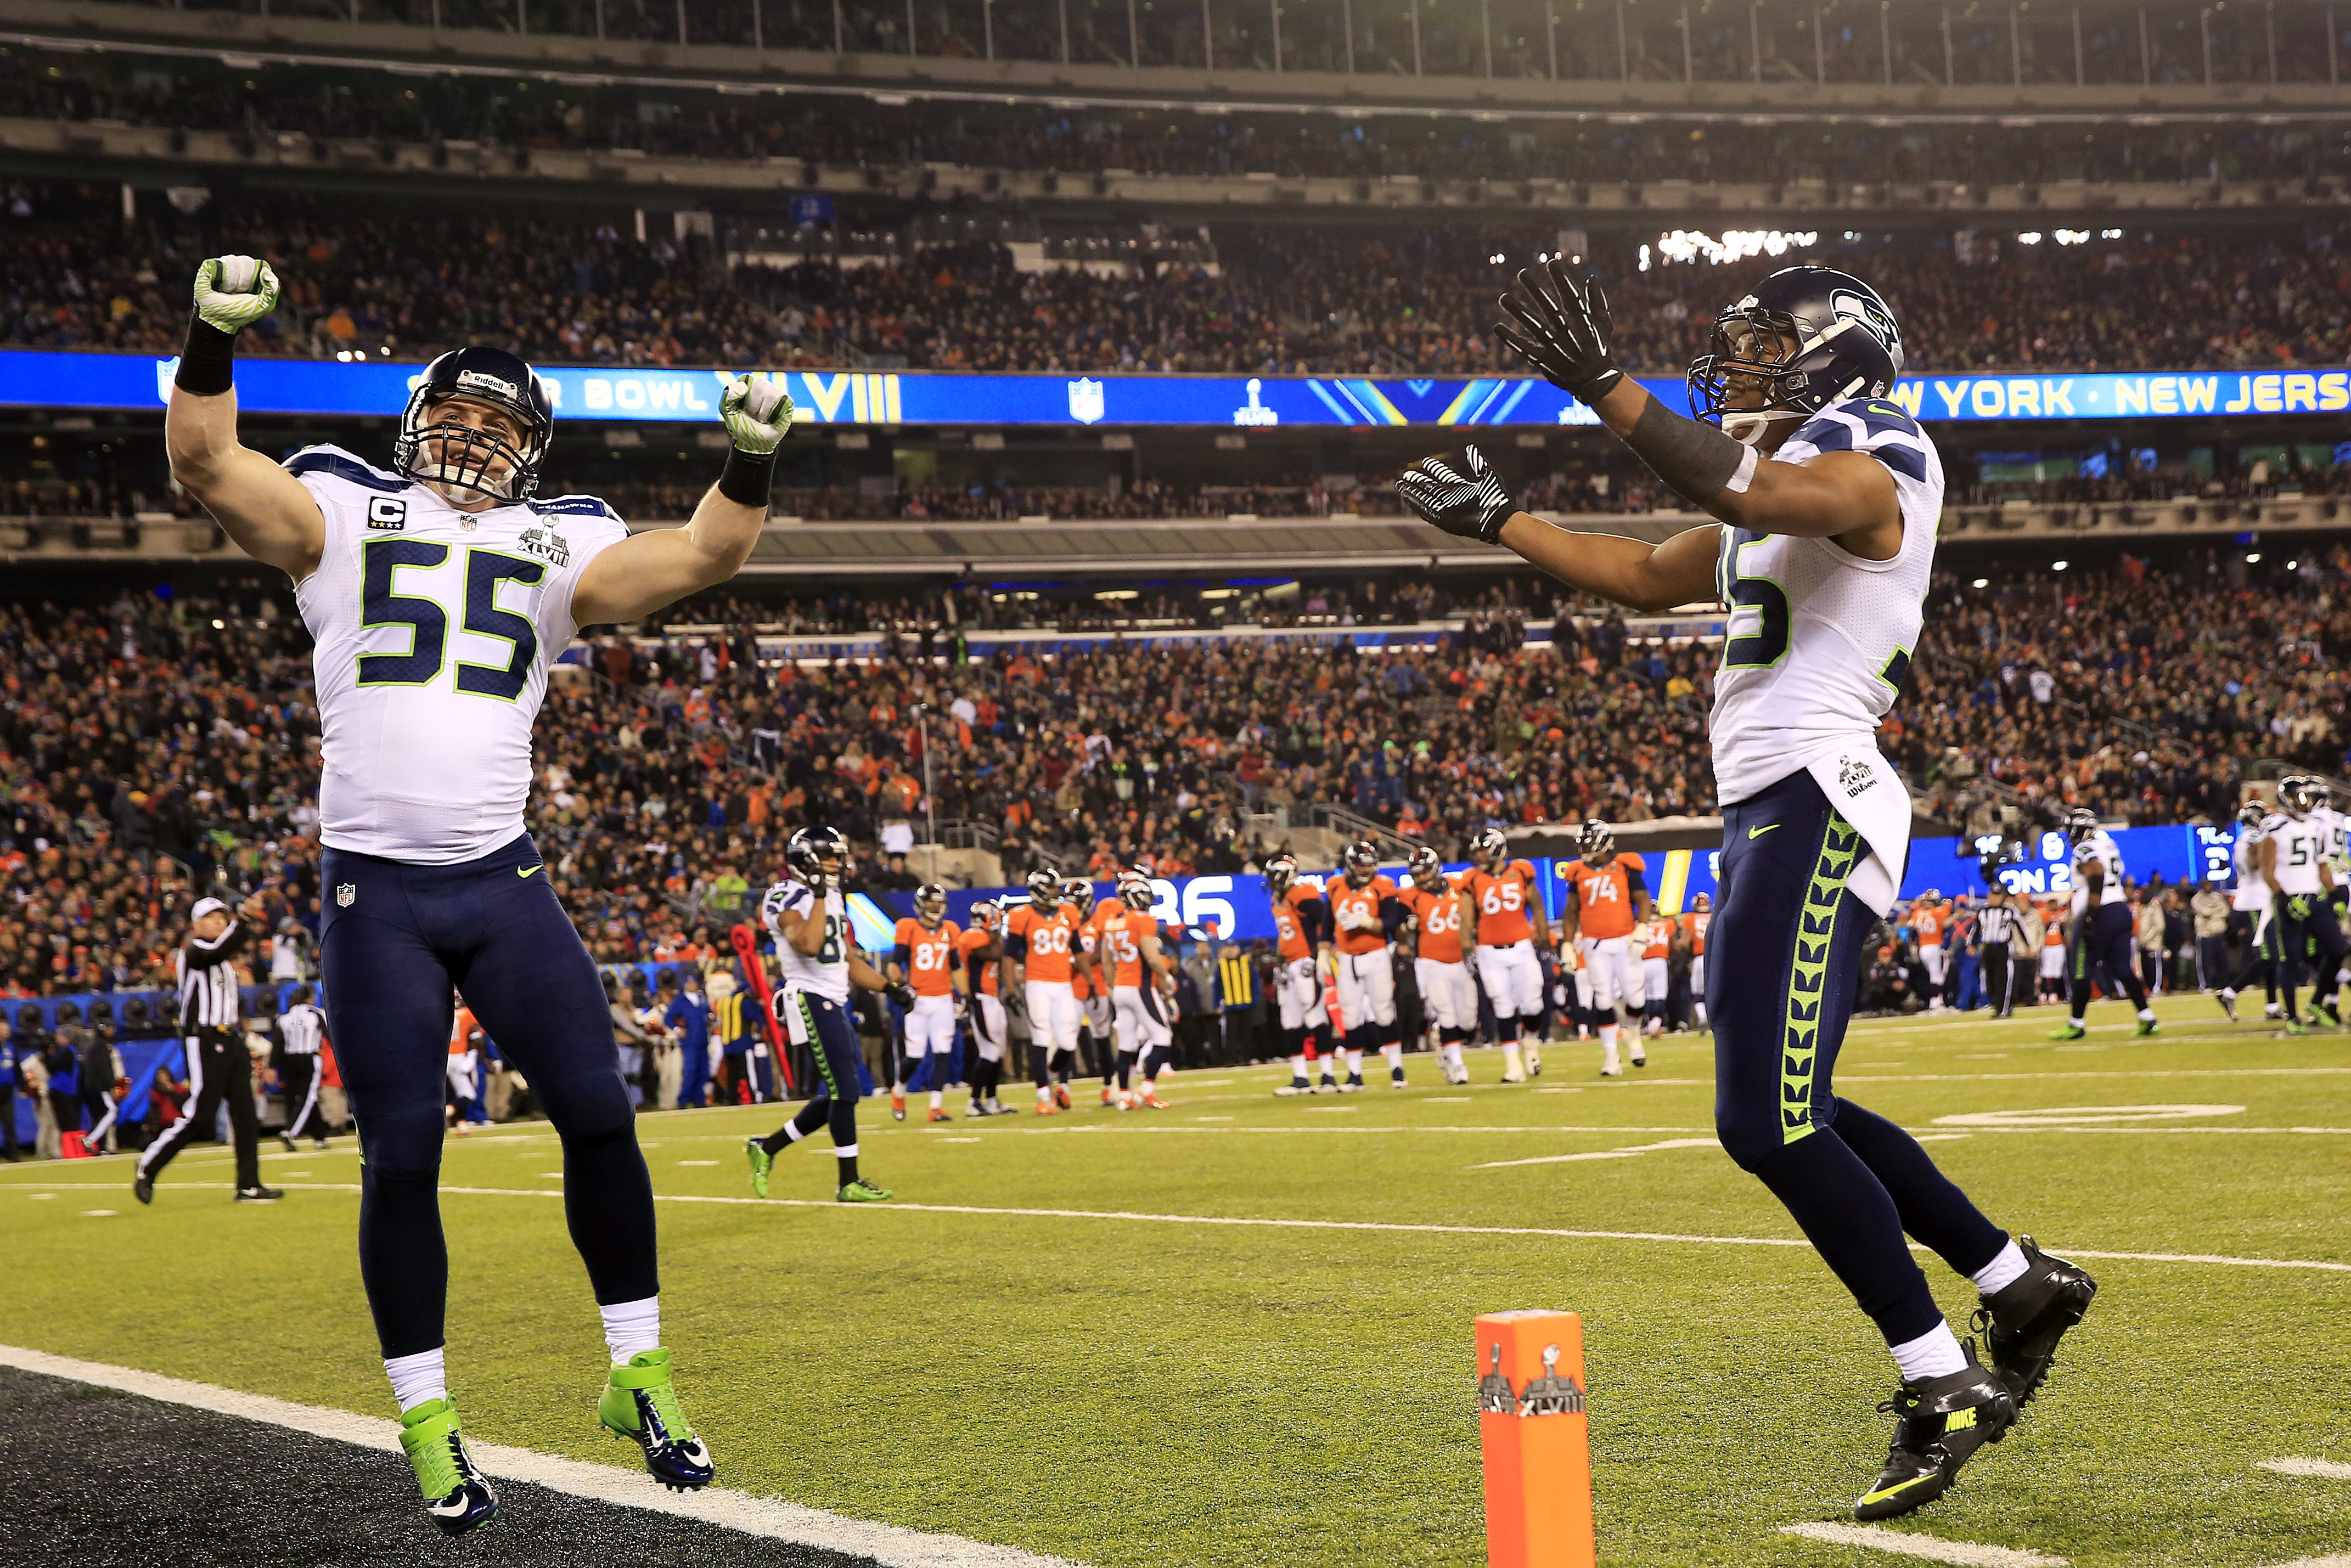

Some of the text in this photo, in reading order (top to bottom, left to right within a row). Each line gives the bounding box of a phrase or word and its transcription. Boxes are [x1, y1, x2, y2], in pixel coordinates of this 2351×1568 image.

[475, 376, 503, 390] Riddell
[584, 378, 708, 410] BOWL
[1935, 379, 2076, 418] YORK
[2115, 376, 2218, 414] NEW
[2225, 373, 2351, 413] JERS
[370, 498, 404, 523] C
[461, 521, 476, 531] NFL
[517, 538, 570, 568] XLVIII
[1720, 529, 1792, 670] 5
[356, 537, 548, 703] 55
[1847, 779, 1877, 798] Wilson
[340, 894, 352, 904] NFL
[1482, 882, 1522, 915] 65
[1584, 874, 1618, 906] 74
[1427, 903, 1462, 935] 66
[915, 941, 950, 971] 87
[1032, 926, 1071, 956] 80
[1518, 1395, 1586, 1417] XLVIII
[1944, 1406, 1977, 1432] NIKE
